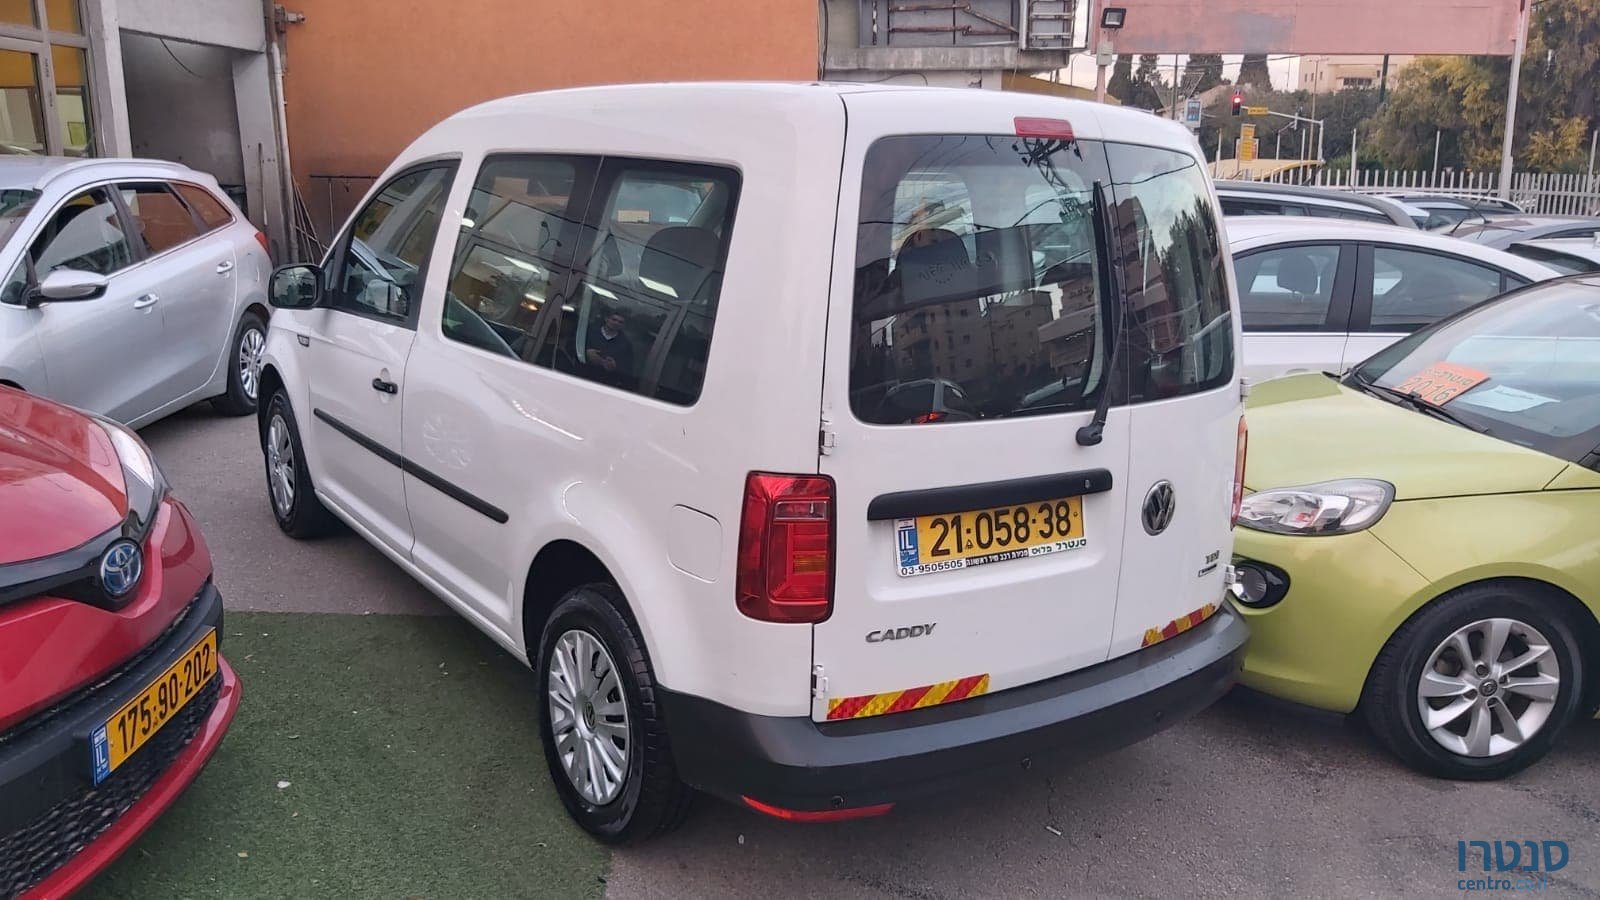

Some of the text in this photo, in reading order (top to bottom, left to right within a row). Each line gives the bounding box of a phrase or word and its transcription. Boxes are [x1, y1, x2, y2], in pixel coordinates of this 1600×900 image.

[1399, 377, 1457, 402] 2016
[900, 530, 914, 550] IL
[1056, 539, 1087, 550] סנטרל
[901, 560, 963, 576] 03-9505505
[865, 622, 937, 643] CADDY
[95, 742, 107, 767] IL
